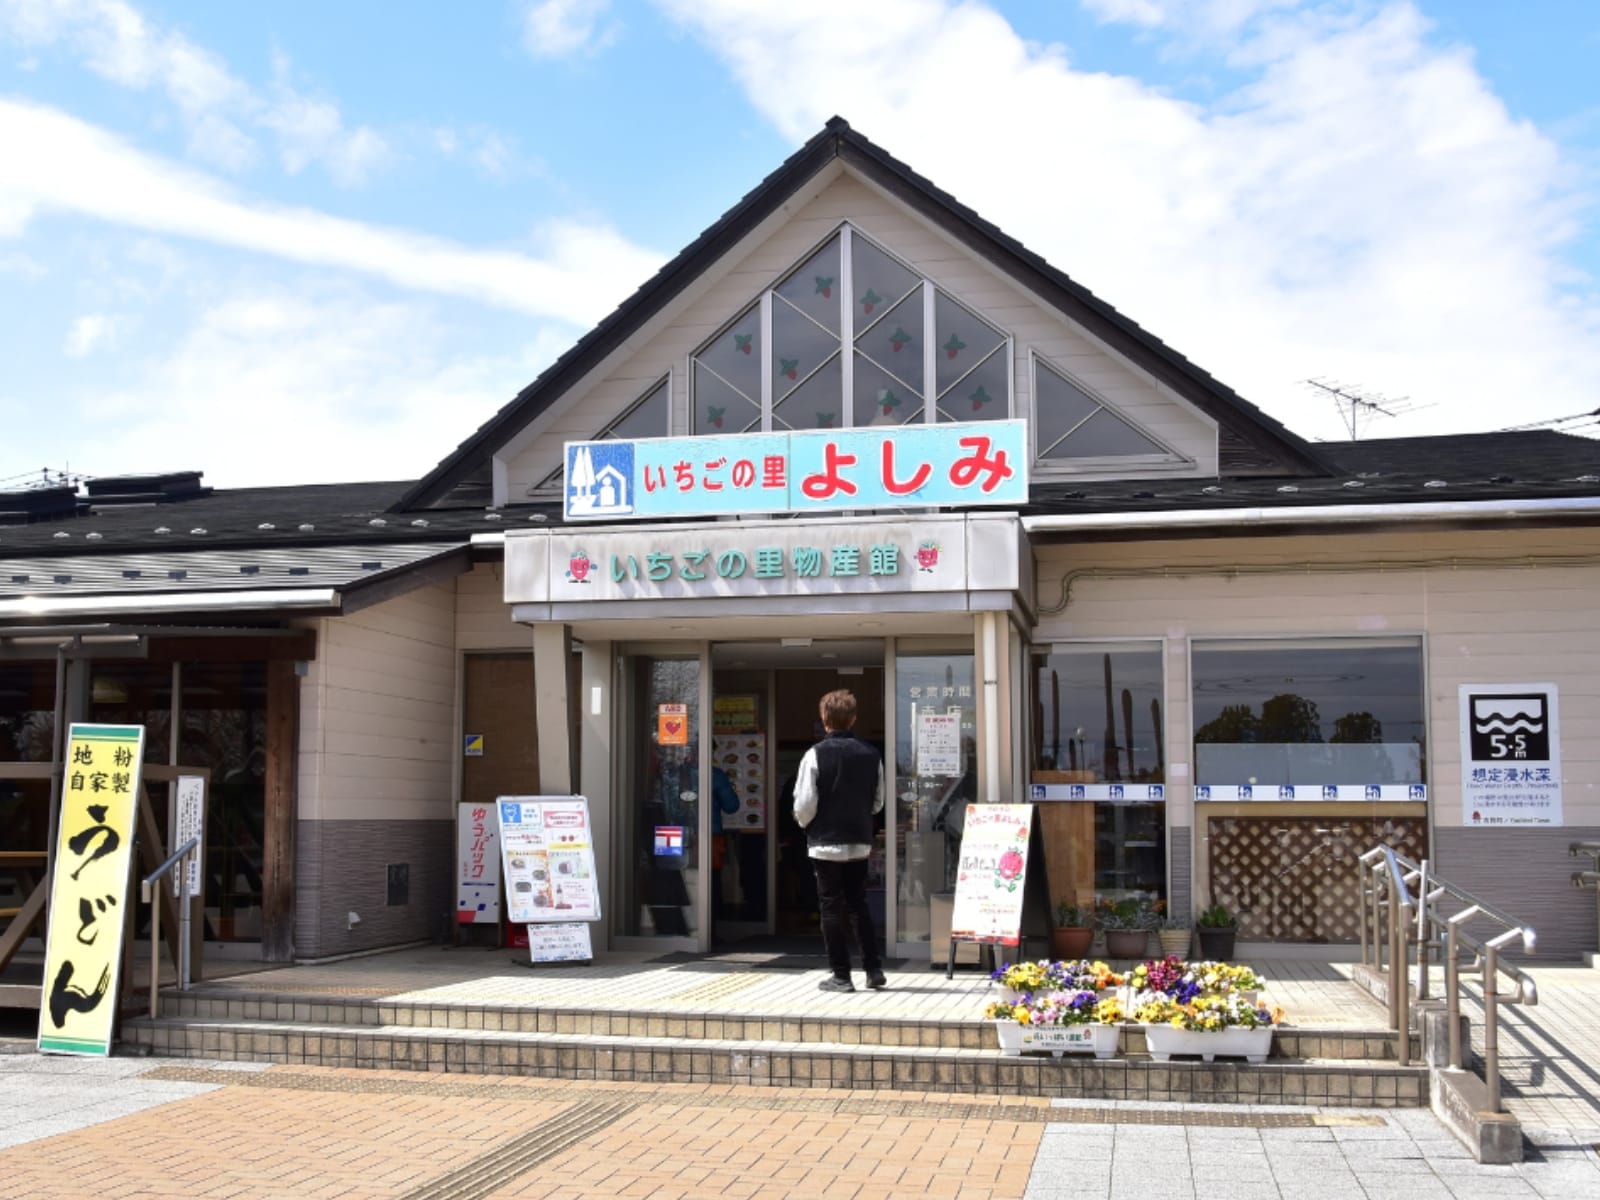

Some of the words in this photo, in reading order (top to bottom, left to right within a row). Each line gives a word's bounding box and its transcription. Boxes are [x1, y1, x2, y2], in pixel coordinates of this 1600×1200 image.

[643, 454, 787, 494] いちごの里
[800, 436, 1013, 499] よしみ
[610, 543, 901, 584] いちごの里物産館
[70, 770, 131, 794] 自家製
[1472, 767, 1551, 782] 想定浸水深
[470, 807, 490, 879] ゆうパック
[49, 804, 120, 1029] うどん
